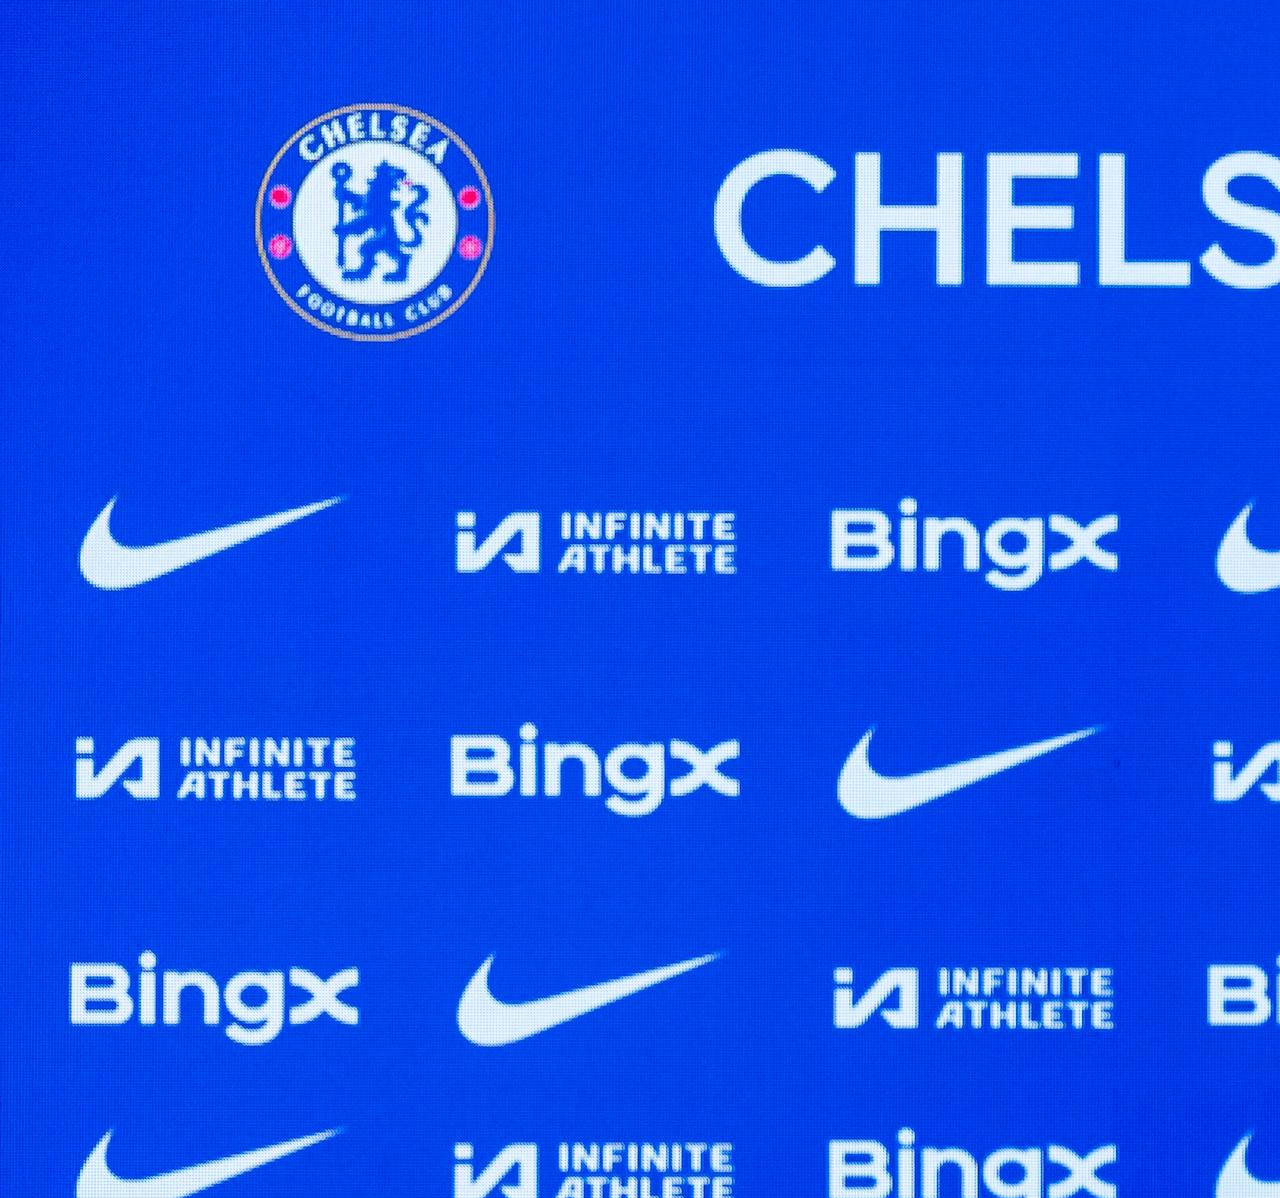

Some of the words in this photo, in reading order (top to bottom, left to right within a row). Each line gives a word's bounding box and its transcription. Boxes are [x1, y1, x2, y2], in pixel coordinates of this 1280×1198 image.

[298, 112, 450, 165] CHELSEA
[563, 513, 735, 541] INFINITE
[559, 545, 735, 575] ATHLETE
[181, 738, 354, 768] INFINITE
[178, 772, 357, 801] ATHLETE
[941, 969, 1111, 996] INFINITE
[938, 1002, 1114, 1030] ATHLETE
[560, 1144, 733, 1173] INFINITE
